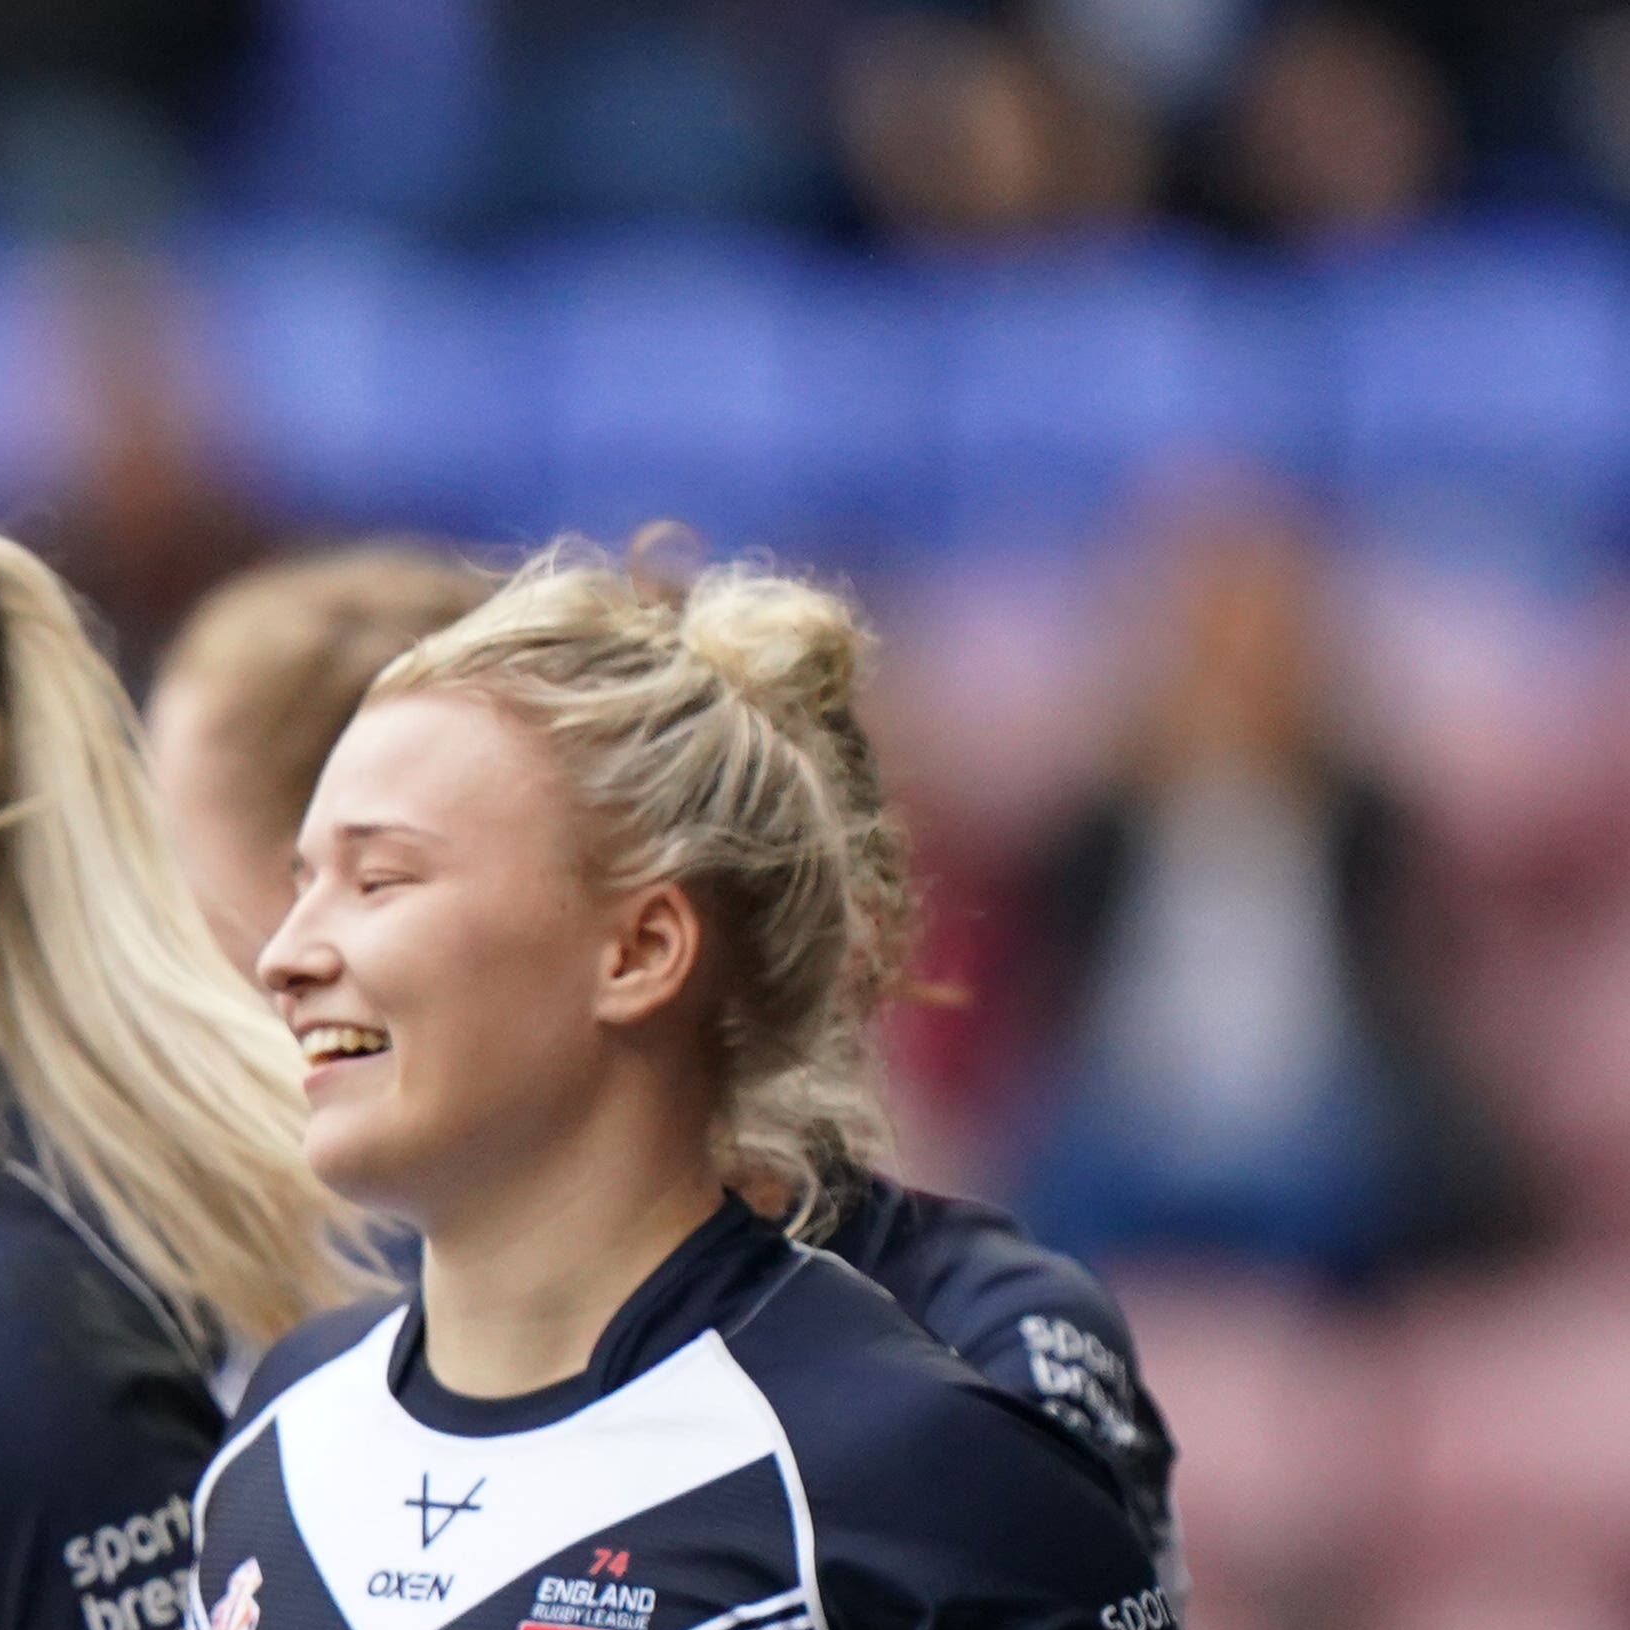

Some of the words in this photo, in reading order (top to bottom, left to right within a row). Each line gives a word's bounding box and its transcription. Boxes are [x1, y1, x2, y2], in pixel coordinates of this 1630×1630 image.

[589, 1547, 630, 1578] 74
[367, 1569, 454, 1601] OXEN
[537, 1576, 657, 1613] ENGLAND
